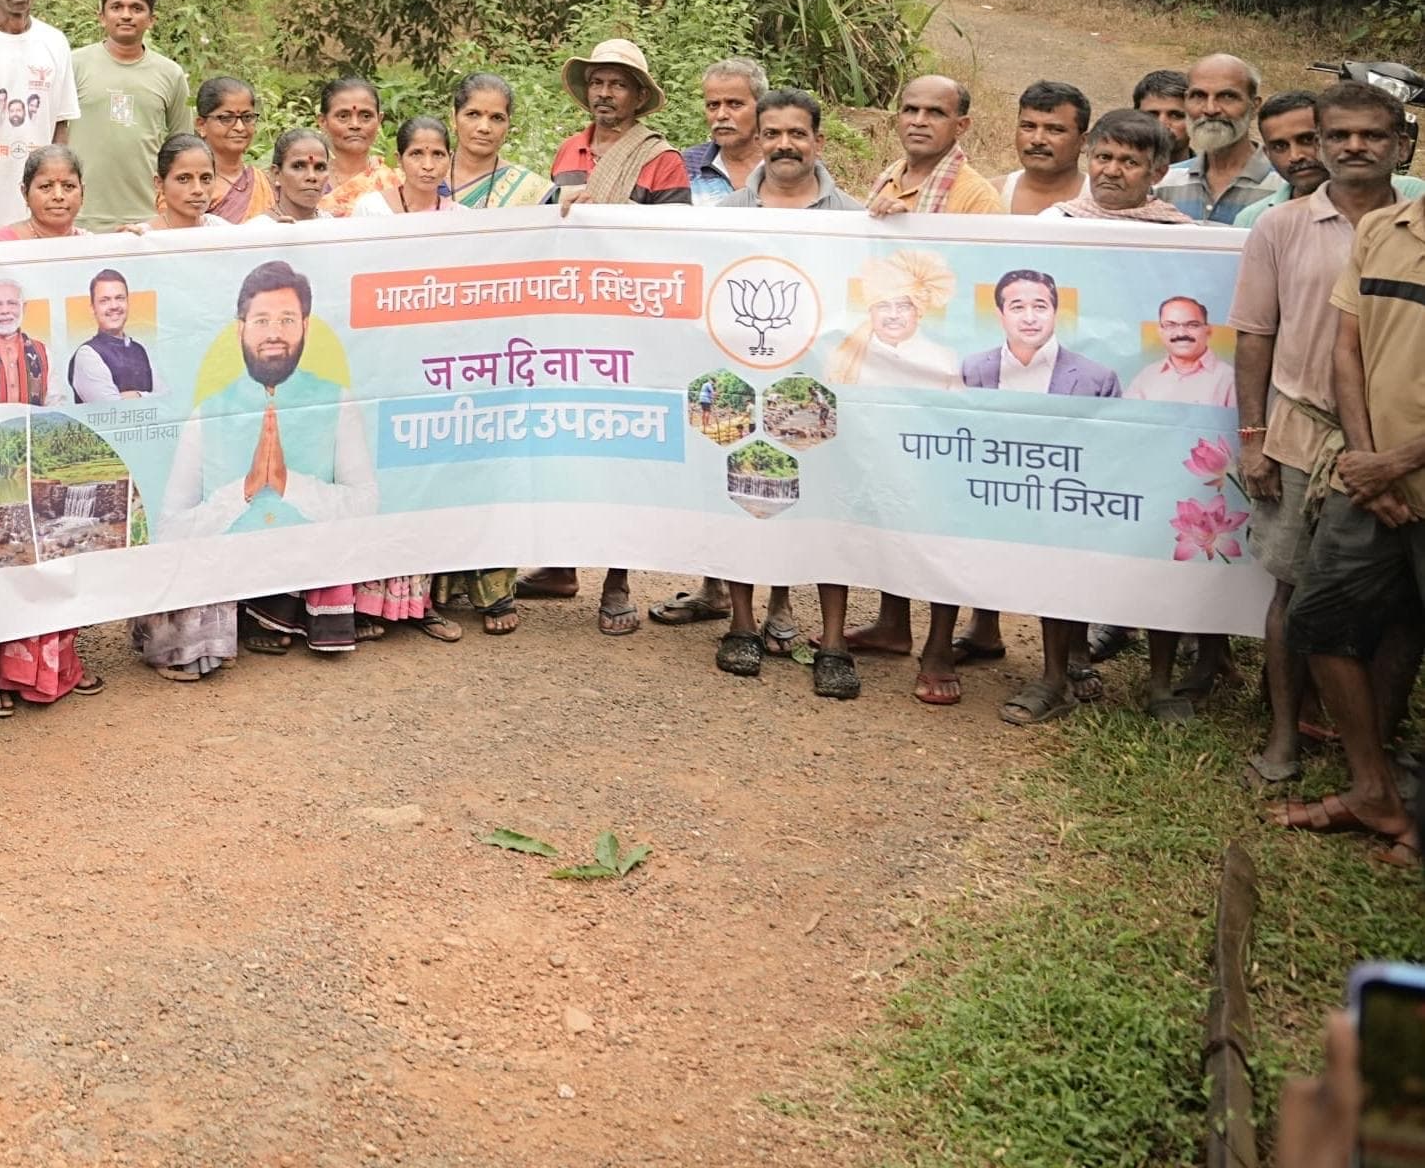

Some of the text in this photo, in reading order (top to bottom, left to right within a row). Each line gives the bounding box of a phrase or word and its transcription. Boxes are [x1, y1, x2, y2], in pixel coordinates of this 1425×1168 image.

[375, 266, 686, 317] भारतीय जनता पार्टी, सिंधुदुर्ग
[86, 408, 117, 427] पाणी
[391, 396, 669, 450] पाणीदार उपक्रम
[899, 427, 1084, 473] पाणी आडवा
[966, 474, 1145, 522] पाणी जिरवा
